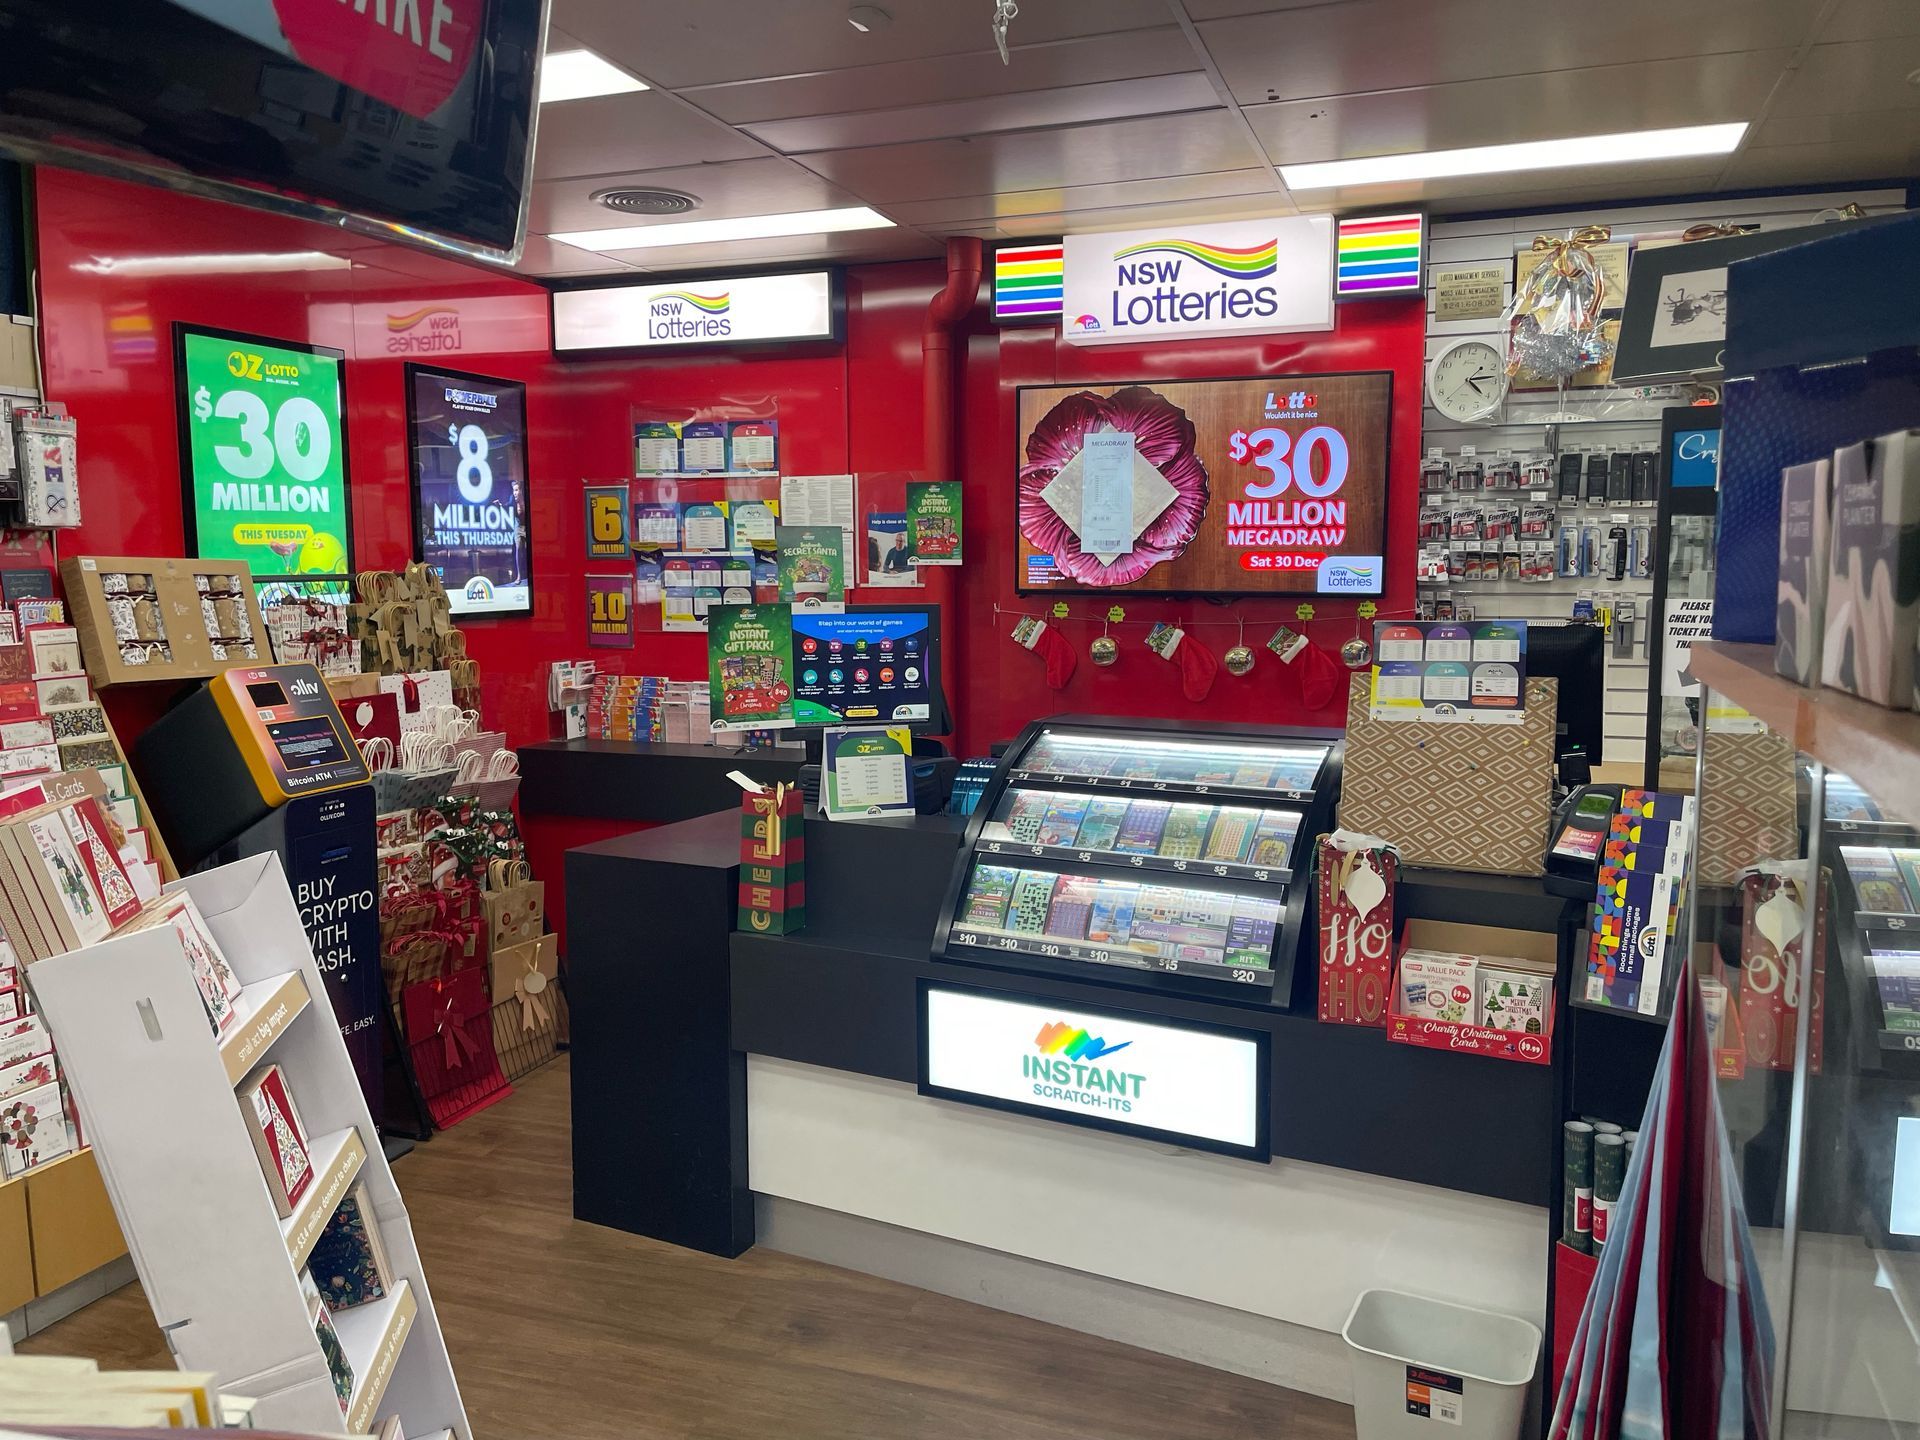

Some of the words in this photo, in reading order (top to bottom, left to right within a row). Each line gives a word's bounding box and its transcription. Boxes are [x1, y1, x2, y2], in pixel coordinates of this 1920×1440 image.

[1118, 260, 1182, 286] NSW
[651, 303, 682, 317] NSW
[1113, 282, 1278, 326] Lotteries
[649, 316, 731, 339] Lotteries
[228, 351, 264, 381] OZ
[265, 364, 299, 378] LOTTO
[1264, 392, 1318, 409] Lotto
[1264, 411, 1290, 420] Wouldn't
[1290, 411, 1296, 419] it
[194, 385, 331, 482] $30
[448, 422, 493, 503] $8
[1229, 426, 1349, 498] $30
[212, 482, 330, 513] MILLION
[434, 503, 515, 530] MILLION
[1227, 501, 1345, 526] MILLION
[1420, 510, 1450, 520] Energizer
[1453, 508, 1483, 519] Energizer
[1487, 510, 1518, 522] Energizer
[1523, 507, 1554, 518] Energizer
[240, 529, 262, 539] THIS
[265, 529, 308, 539] TUESDAY
[436, 531, 461, 545] THIS
[462, 531, 515, 545] THURSDAY
[1227, 529, 1345, 546] MEGADRAW
[592, 544, 625, 554] MILLION
[783, 547, 812, 556] SECRET
[813, 547, 837, 556] SANTA
[1250, 555, 1271, 567] Sat
[1275, 556, 1292, 567] 30
[1294, 555, 1319, 567] Dec
[1330, 569, 1348, 577] NSW
[1328, 575, 1372, 587] Lotteries
[467, 589, 485, 600] Lott
[1680, 602, 1711, 610] PLEASE
[1668, 614, 1698, 623] CHECK
[592, 623, 628, 634] MILLION
[1669, 627, 1699, 636] TICKET
[1699, 628, 1712, 636] HE
[729, 630, 770, 640] INSTANT
[724, 640, 745, 653] GIFT
[745, 640, 774, 652] PACK!
[1435, 707, 1450, 715] Lott
[287, 776, 315, 787] Bitcoin
[315, 772, 333, 781] ATM
[1018, 771, 1030, 781] $1
[1053, 774, 1065, 784] $1
[1087, 776, 1099, 786] $1
[56, 777, 85, 801] Cards
[1120, 778, 1132, 788] $1
[1153, 781, 1167, 791] $2
[1195, 784, 1209, 794] $2
[1287, 790, 1301, 800] $4
[988, 842, 1000, 852] $5
[1031, 846, 1043, 856] $5
[1078, 851, 1092, 862] $5
[1130, 856, 1143, 867] $5
[1173, 860, 1187, 871] $5
[1213, 865, 1228, 877] $5
[1254, 870, 1269, 881] $5
[297, 874, 337, 905] BUY
[299, 890, 374, 929] CRYPTO
[959, 933, 977, 945] $10
[1000, 938, 1018, 950] $10
[1622, 928, 1630, 951] things
[1626, 966, 1633, 974] in
[1631, 907, 1640, 944] packages
[1040, 944, 1059, 956] $10
[1646, 936, 1656, 957] Lott
[316, 944, 356, 973] ASH.
[1090, 949, 1109, 962] $10
[1158, 958, 1179, 971] $15
[1619, 952, 1627, 973] Good
[1232, 969, 1256, 983] $20
[1427, 966, 1448, 974] VALUE
[1449, 968, 1466, 977] PACK
[1329, 970, 1384, 1023] HO
[1510, 998, 1527, 1007] MERRY
[1505, 1006, 1533, 1015] CHRISTMAS
[256, 1022, 272, 1039] big
[266, 1002, 288, 1028] impact
[353, 1014, 376, 1031] EASY.
[1424, 1022, 1459, 1038] Charity
[1461, 1028, 1508, 1042] Christmas
[1450, 1037, 1480, 1049] Cards
[1023, 1054, 1147, 1099] INSTANT
[1033, 1083, 1133, 1113] SCRATCH-ITS
[321, 1176, 340, 1208] donated
[337, 1170, 343, 1182] to
[342, 1150, 358, 1173] charity
